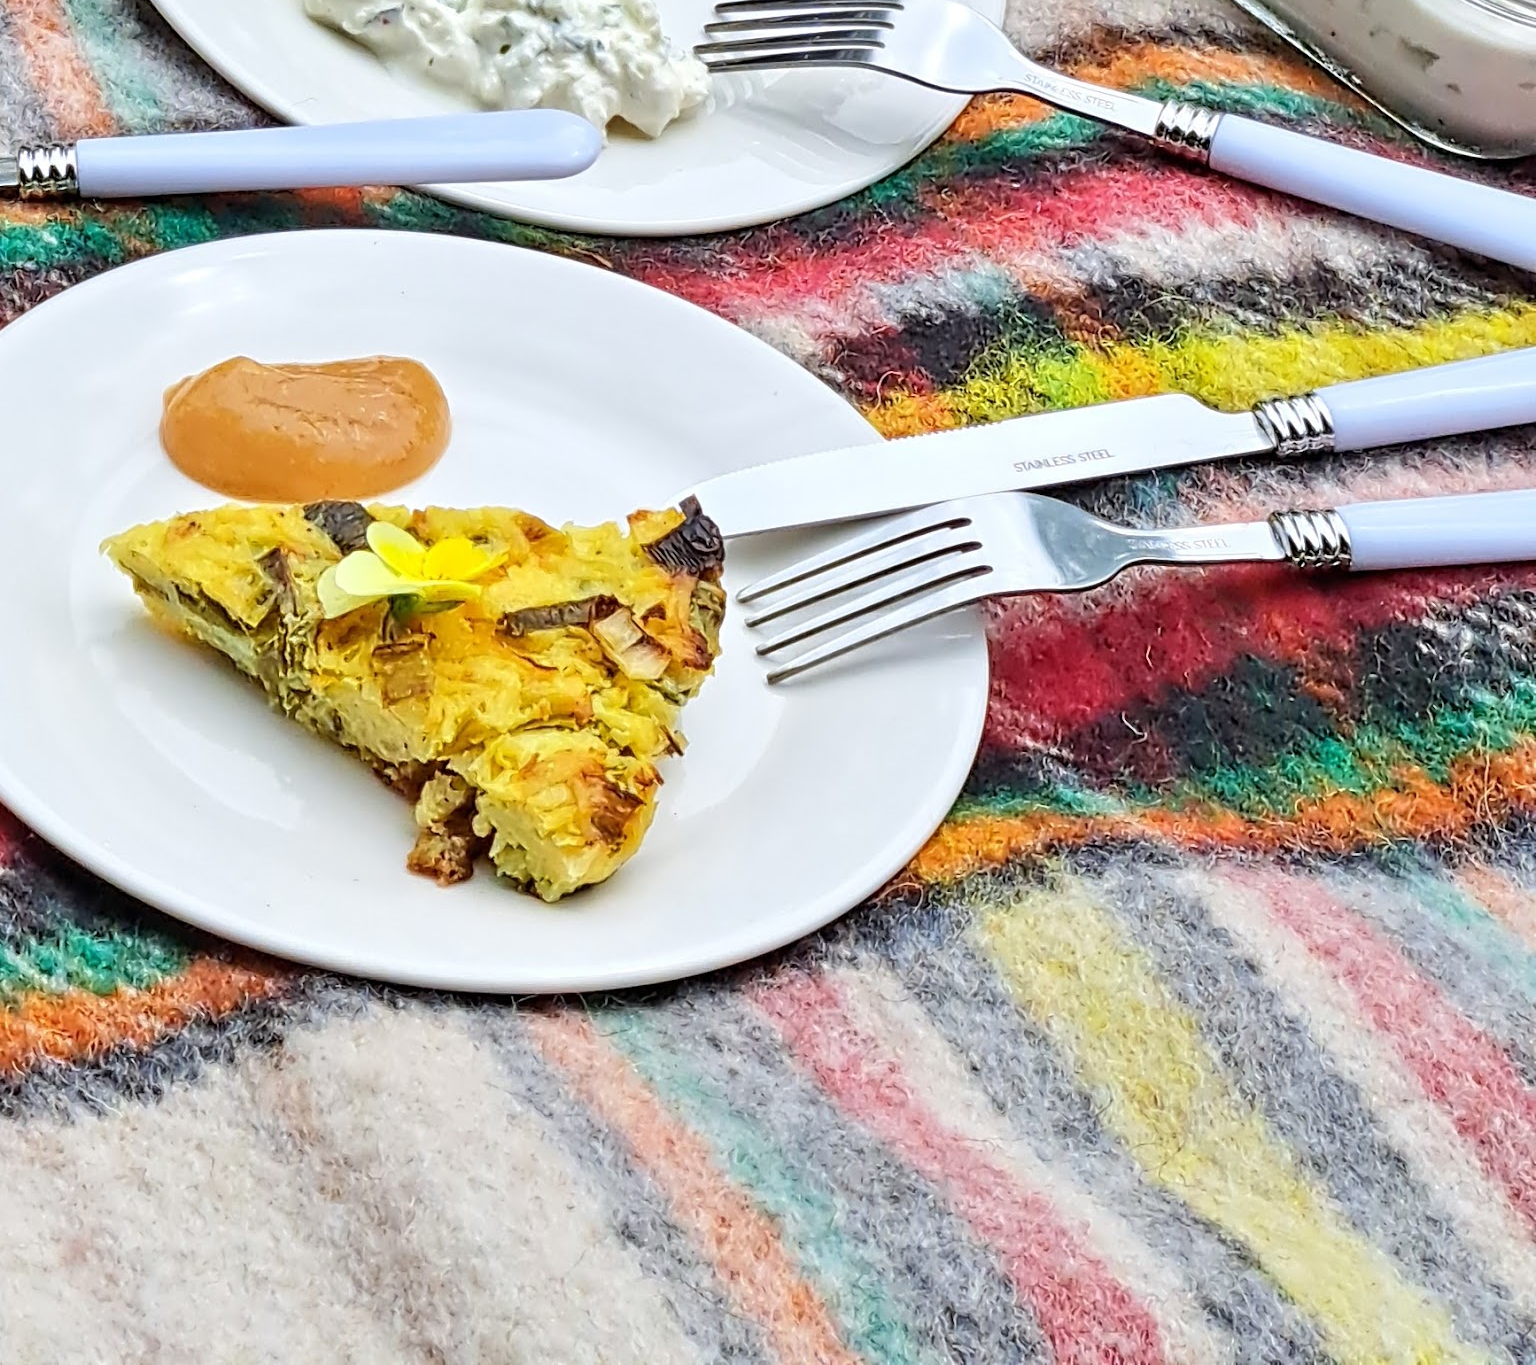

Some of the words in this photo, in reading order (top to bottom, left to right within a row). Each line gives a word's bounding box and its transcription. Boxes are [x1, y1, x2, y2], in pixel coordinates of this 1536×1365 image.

[1013, 454, 1077, 473] STAINLESS
[1078, 448, 1116, 462] STEEL
[1193, 538, 1232, 550] STEEL
